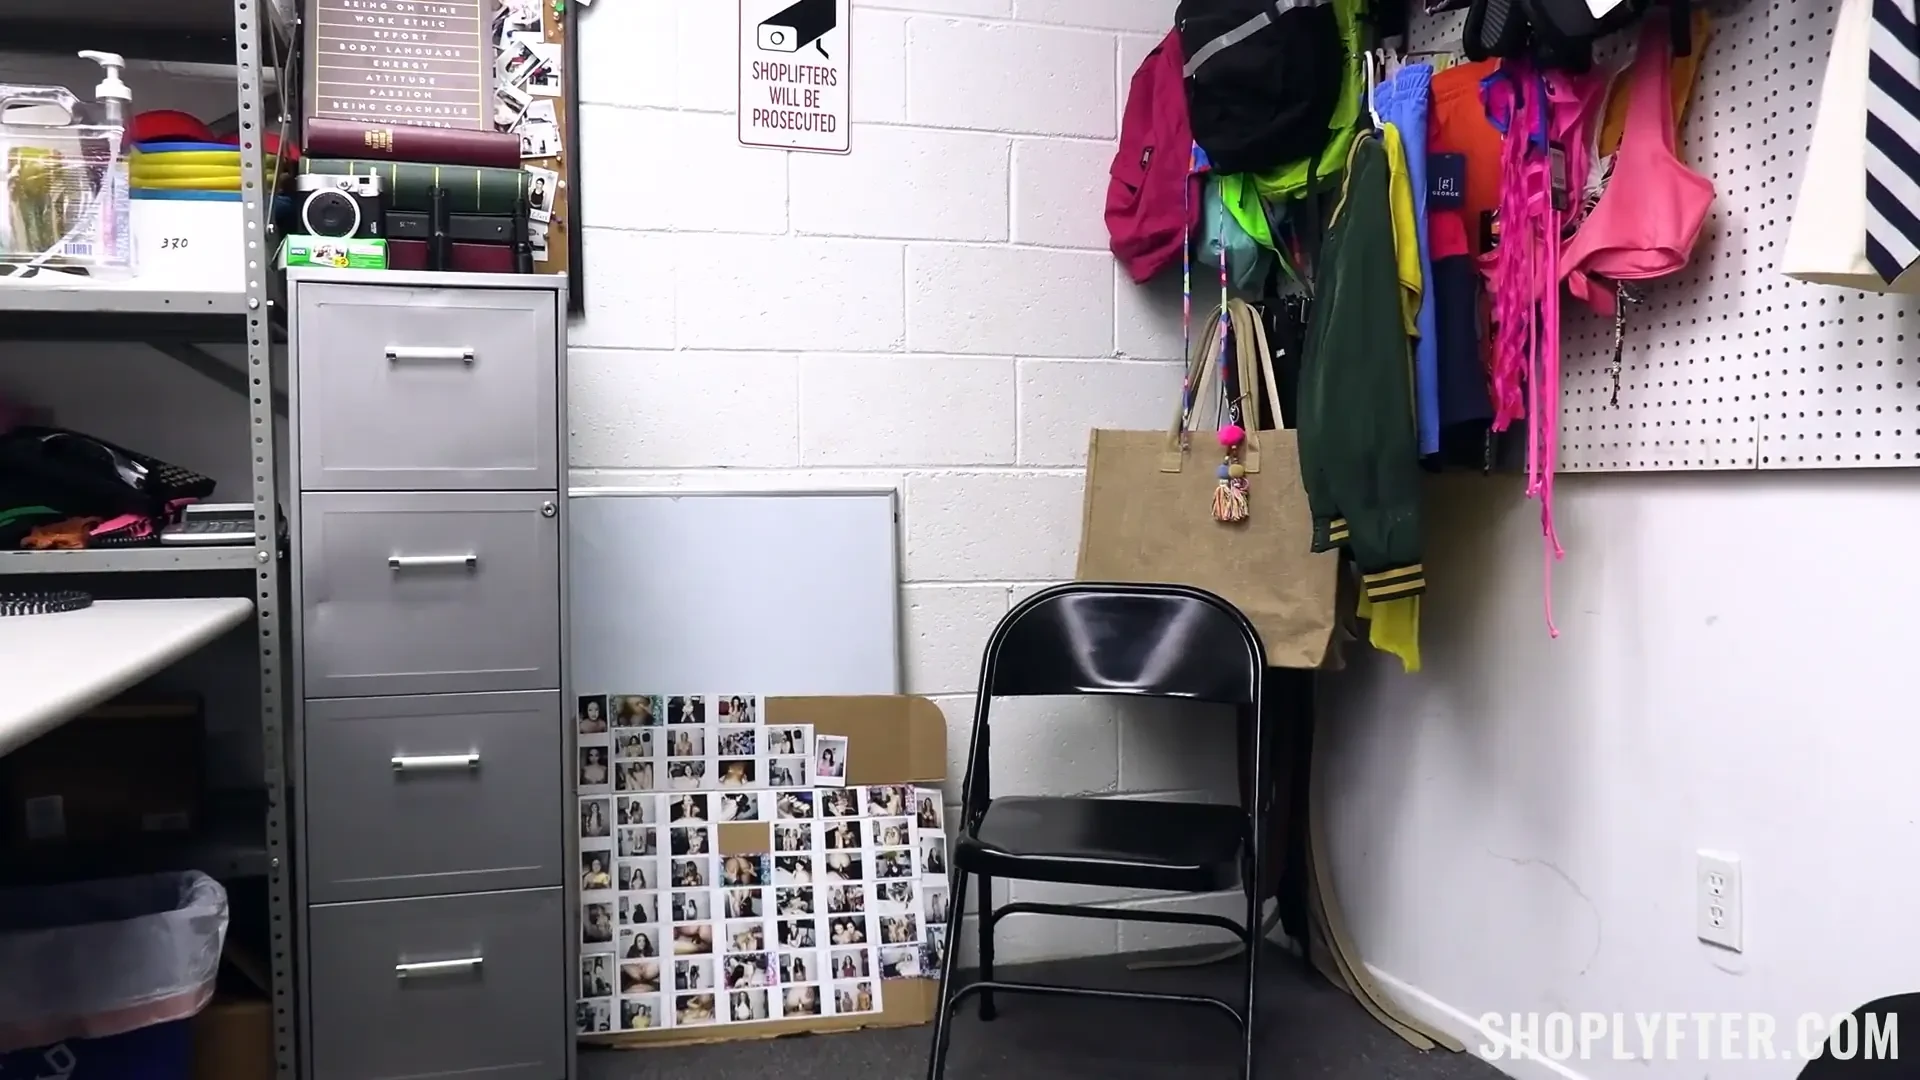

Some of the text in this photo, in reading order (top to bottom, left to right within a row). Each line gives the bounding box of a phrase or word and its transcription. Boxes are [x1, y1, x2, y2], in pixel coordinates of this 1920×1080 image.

[344, 0, 457, 14] BEING ON TIME
[355, 15, 445, 28] WORK ETHIC
[374, 31, 428, 41] EFFORT
[339, 43, 461, 57] BODY LANGUAGE
[373, 60, 429, 69] ENERGY
[366, 74, 436, 85] ATTITUDE
[752, 60, 837, 87] SHOPLIFTERS
[370, 89, 432, 99] PASSION
[769, 85, 820, 109] WILL BE
[333, 101, 468, 115] BEING COACHABLE
[753, 108, 836, 133] PROSECUTED
[161, 237, 188, 250] 370
